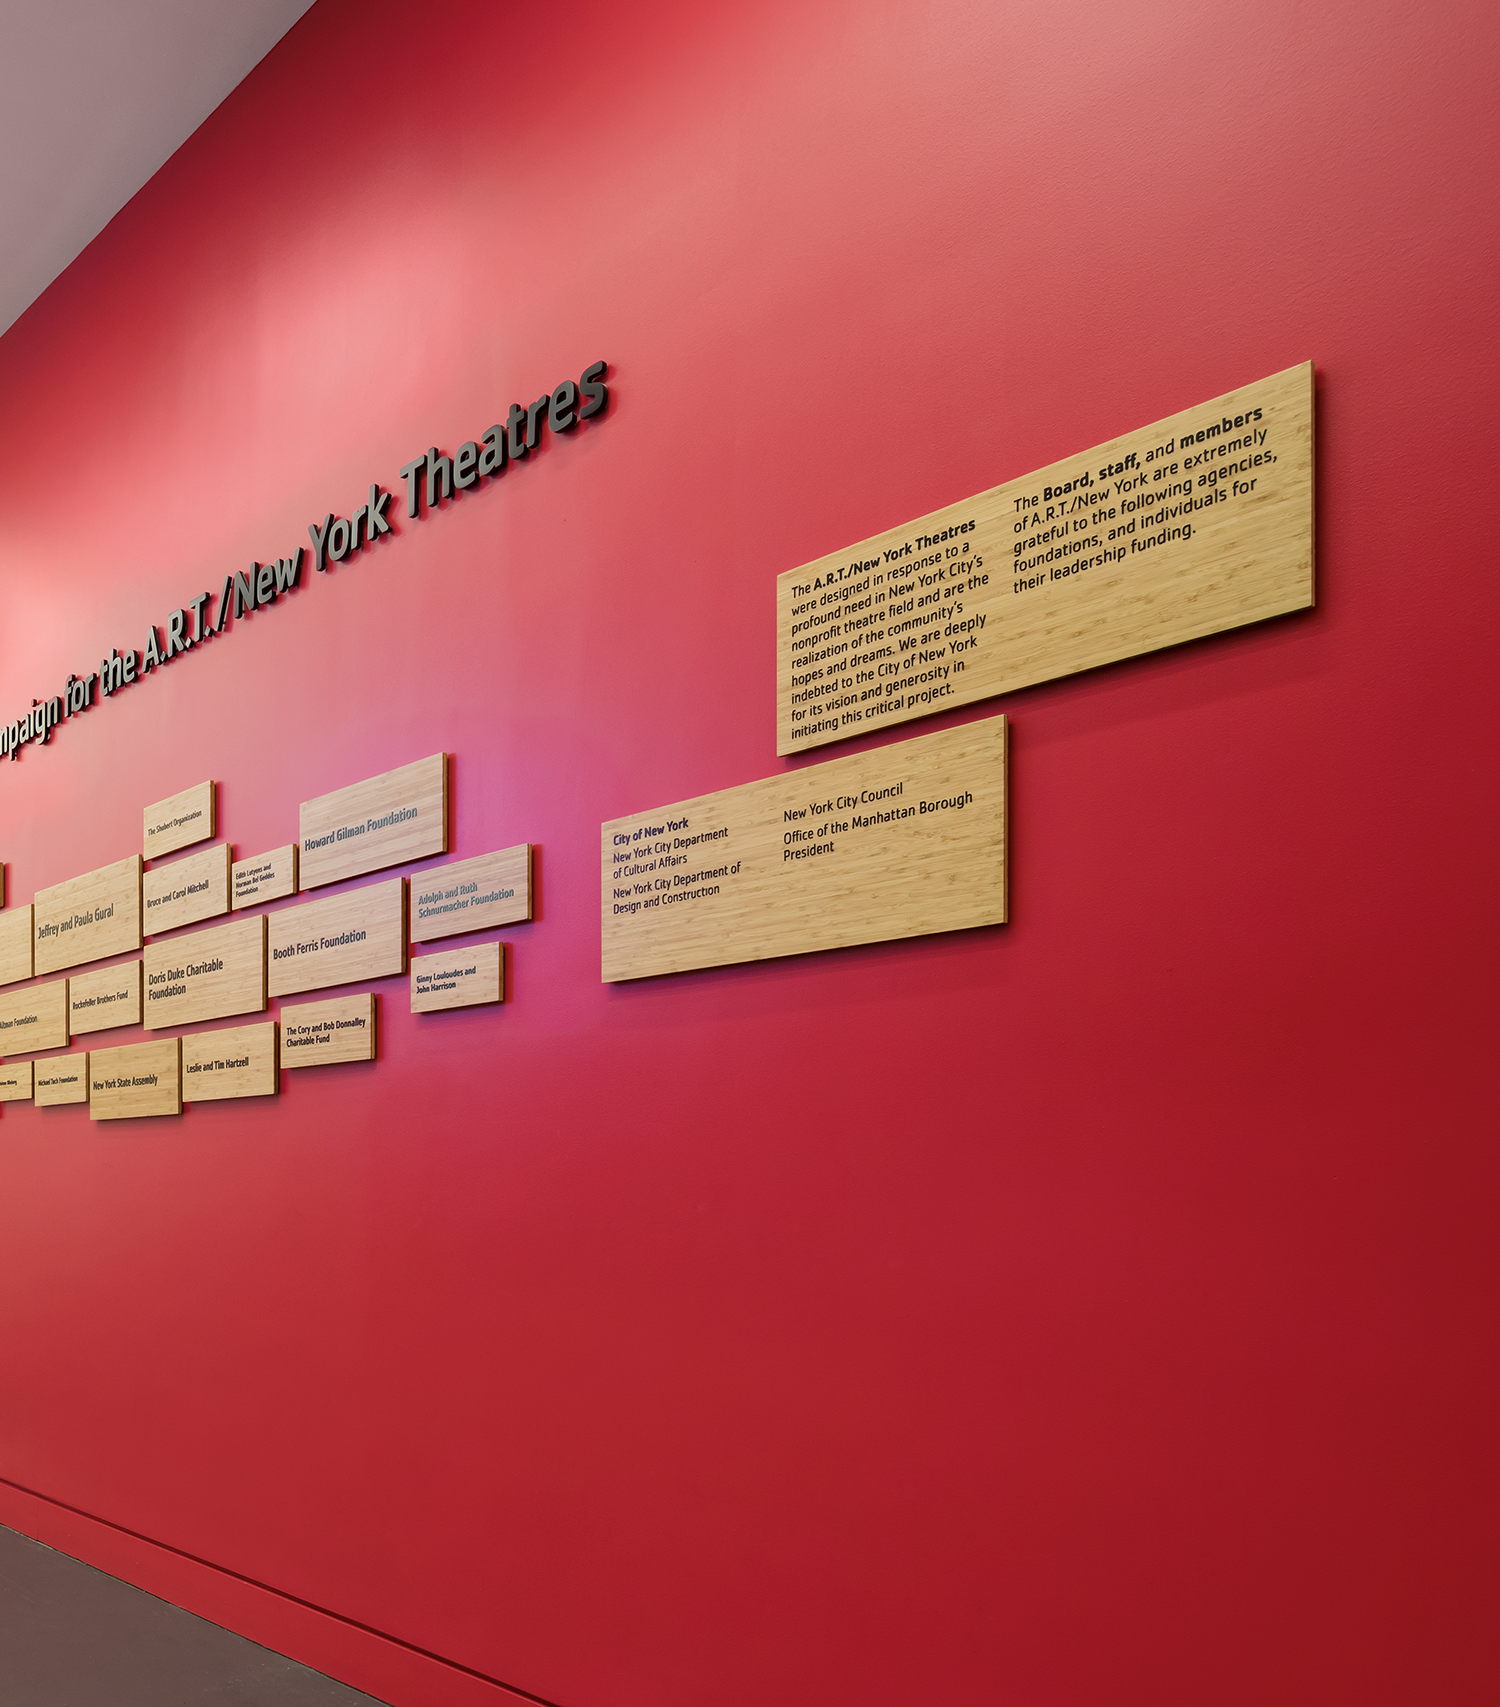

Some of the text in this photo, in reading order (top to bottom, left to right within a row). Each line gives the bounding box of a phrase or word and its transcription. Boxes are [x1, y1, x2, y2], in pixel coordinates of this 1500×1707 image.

[1013, 407, 1262, 512] The Board, staff, and members
[1013, 428, 1267, 533] of A.R.T./New York are extremely
[64, 673, 98, 717] for
[100, 648, 140, 697] the
[142, 546, 304, 673] A.R.T./New
[308, 483, 392, 571] York
[400, 360, 609, 518] Theatres
[791, 519, 975, 598] The A.R.T./New York Theatres
[783, 781, 902, 822] New York City Council
[147, 810, 202, 836] The Shubert Organization
[304, 807, 417, 851] Howard Gilman Foundation
[613, 817, 688, 846] City of New York
[783, 790, 972, 845] Office of the Manhattan Borough
[613, 826, 728, 863] New York City Department
[783, 840, 834, 861] President
[613, 854, 687, 879] of Cultural Affairs
[613, 860, 741, 899] New York City Department of
[146, 879, 209, 908] Bruce and Carol Mitchell
[417, 881, 478, 905] Adolph and Ruth
[418, 888, 514, 918] Schnurmacher Foundation
[613, 901, 641, 914] Design
[643, 894, 659, 908] and
[37, 902, 113, 939] Jeffrey and Paula Gural
[273, 929, 366, 960] Booth Ferris Foundation
[148, 957, 223, 985] Doris Duke Charitable
[416, 974, 432, 983] Ginny
[464, 965, 476, 975] and
[72, 989, 128, 1010] Rockefeller Brothers Fund
[148, 983, 186, 1000] Foundation
[416, 981, 456, 994] John Harrison
[286, 1017, 366, 1035] The Cory and Bob Donnalley
[286, 1033, 330, 1047] Charitable Fund
[186, 1056, 249, 1073] Leslie and Tim Hartzell
[92, 1073, 158, 1090] New York State Assembly
